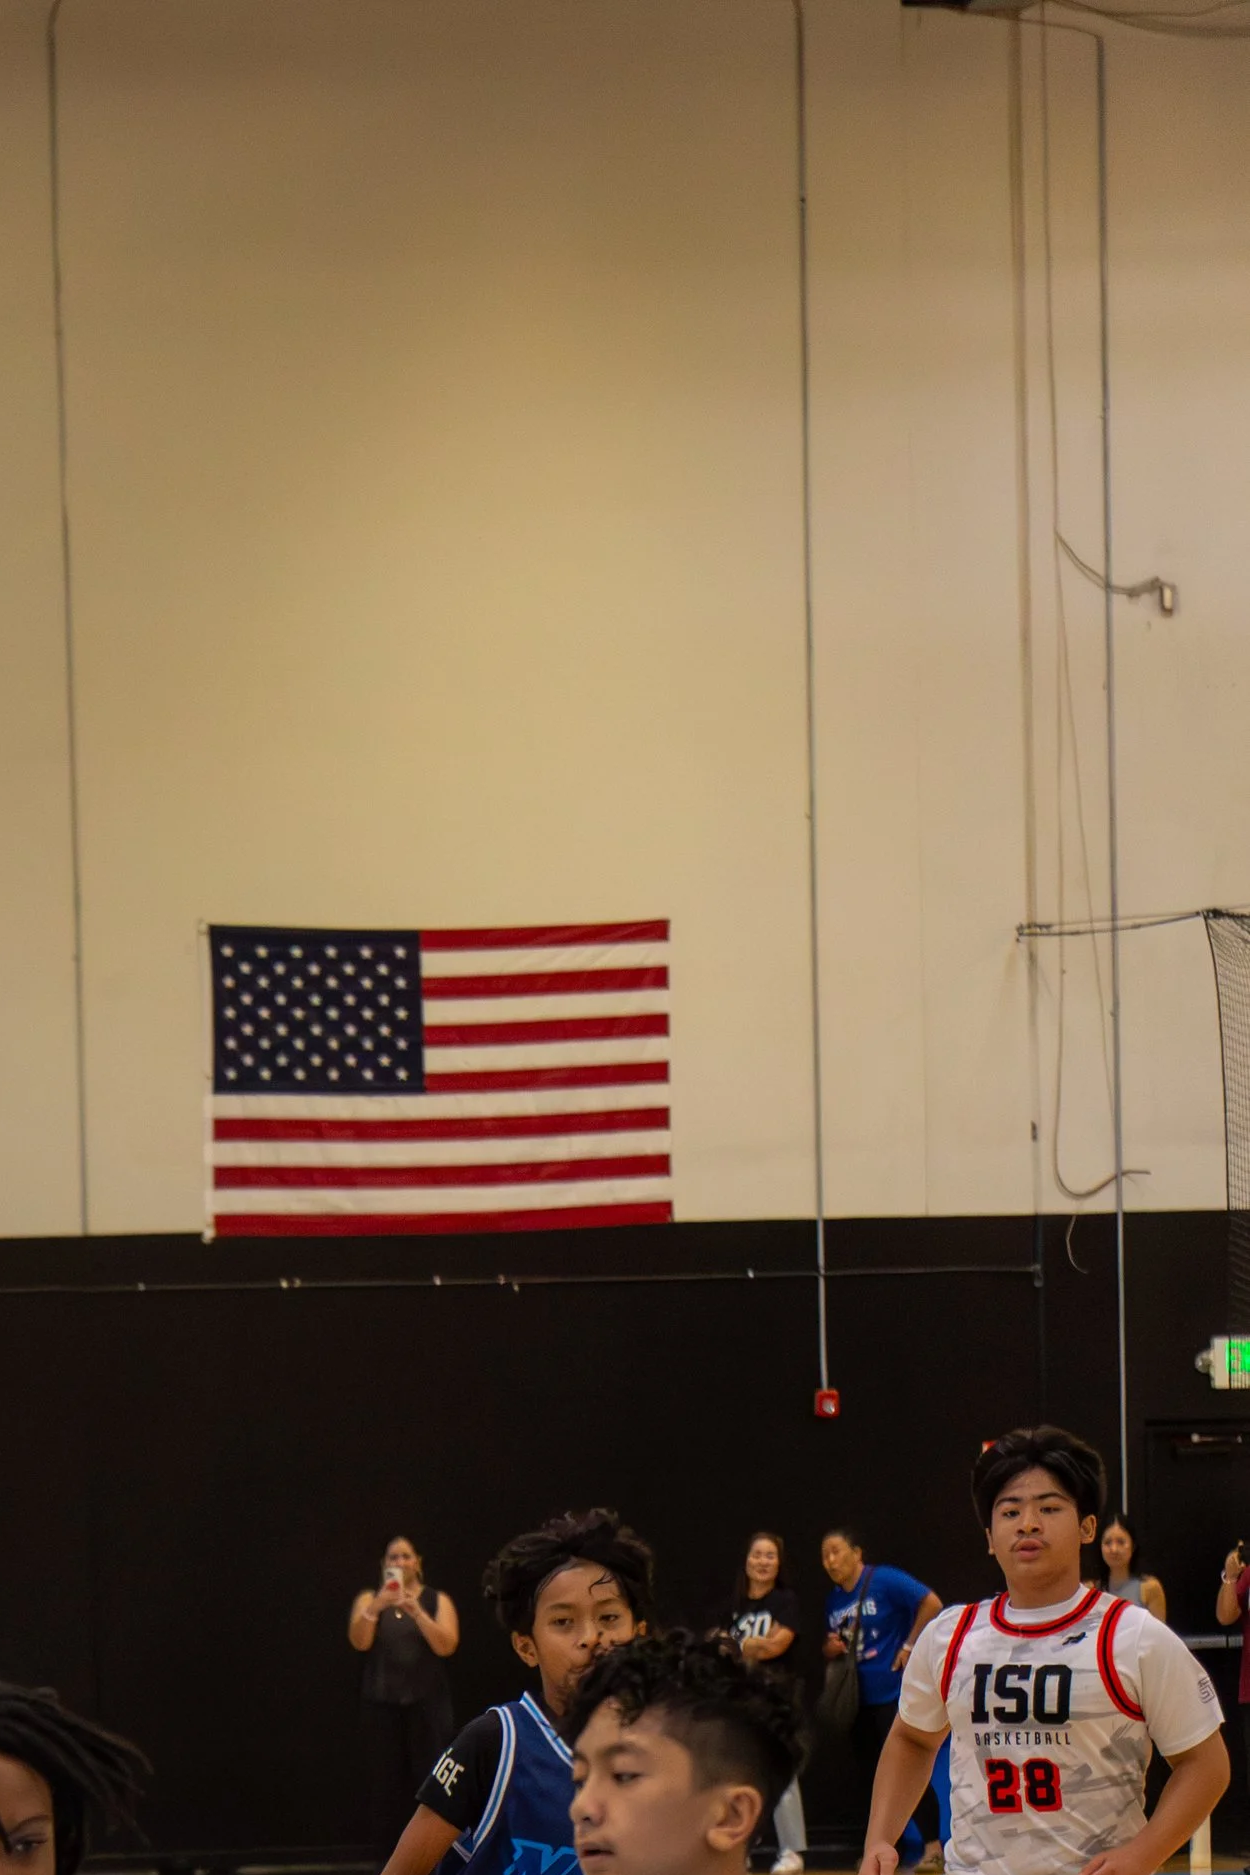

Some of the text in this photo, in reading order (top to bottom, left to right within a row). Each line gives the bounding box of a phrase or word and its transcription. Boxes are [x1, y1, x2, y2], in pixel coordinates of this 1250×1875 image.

[971, 1663, 1072, 1725] ISO
[974, 1731, 1071, 1746] BASKETBALL
[985, 1757, 1063, 1813] 28
